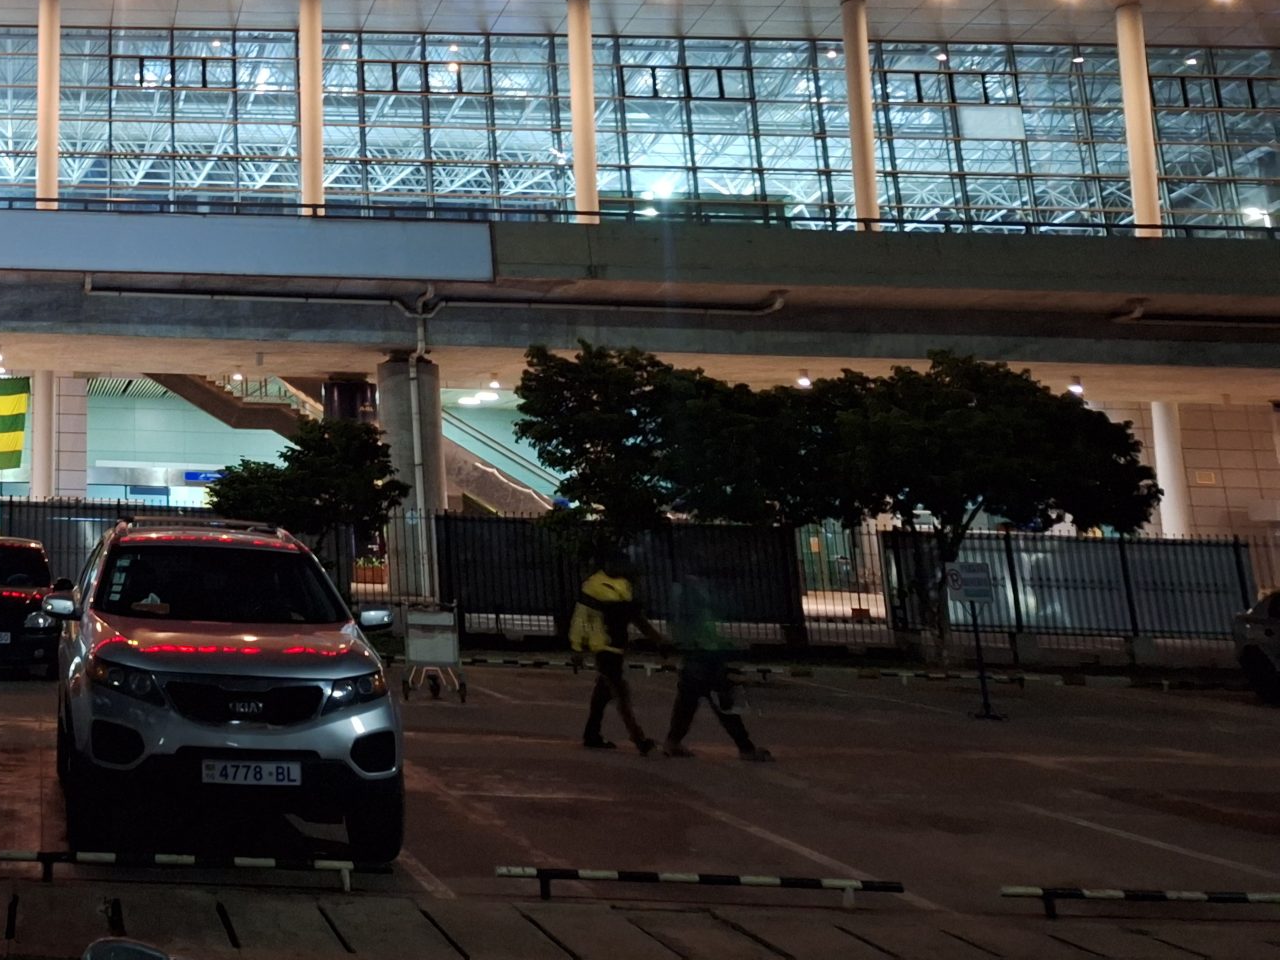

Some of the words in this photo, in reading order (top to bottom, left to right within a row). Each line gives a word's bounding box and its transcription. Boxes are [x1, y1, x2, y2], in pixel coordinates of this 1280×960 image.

[235, 702, 258, 712] KIA
[219, 764, 263, 782] 4778
[275, 765, 297, 782] BL
